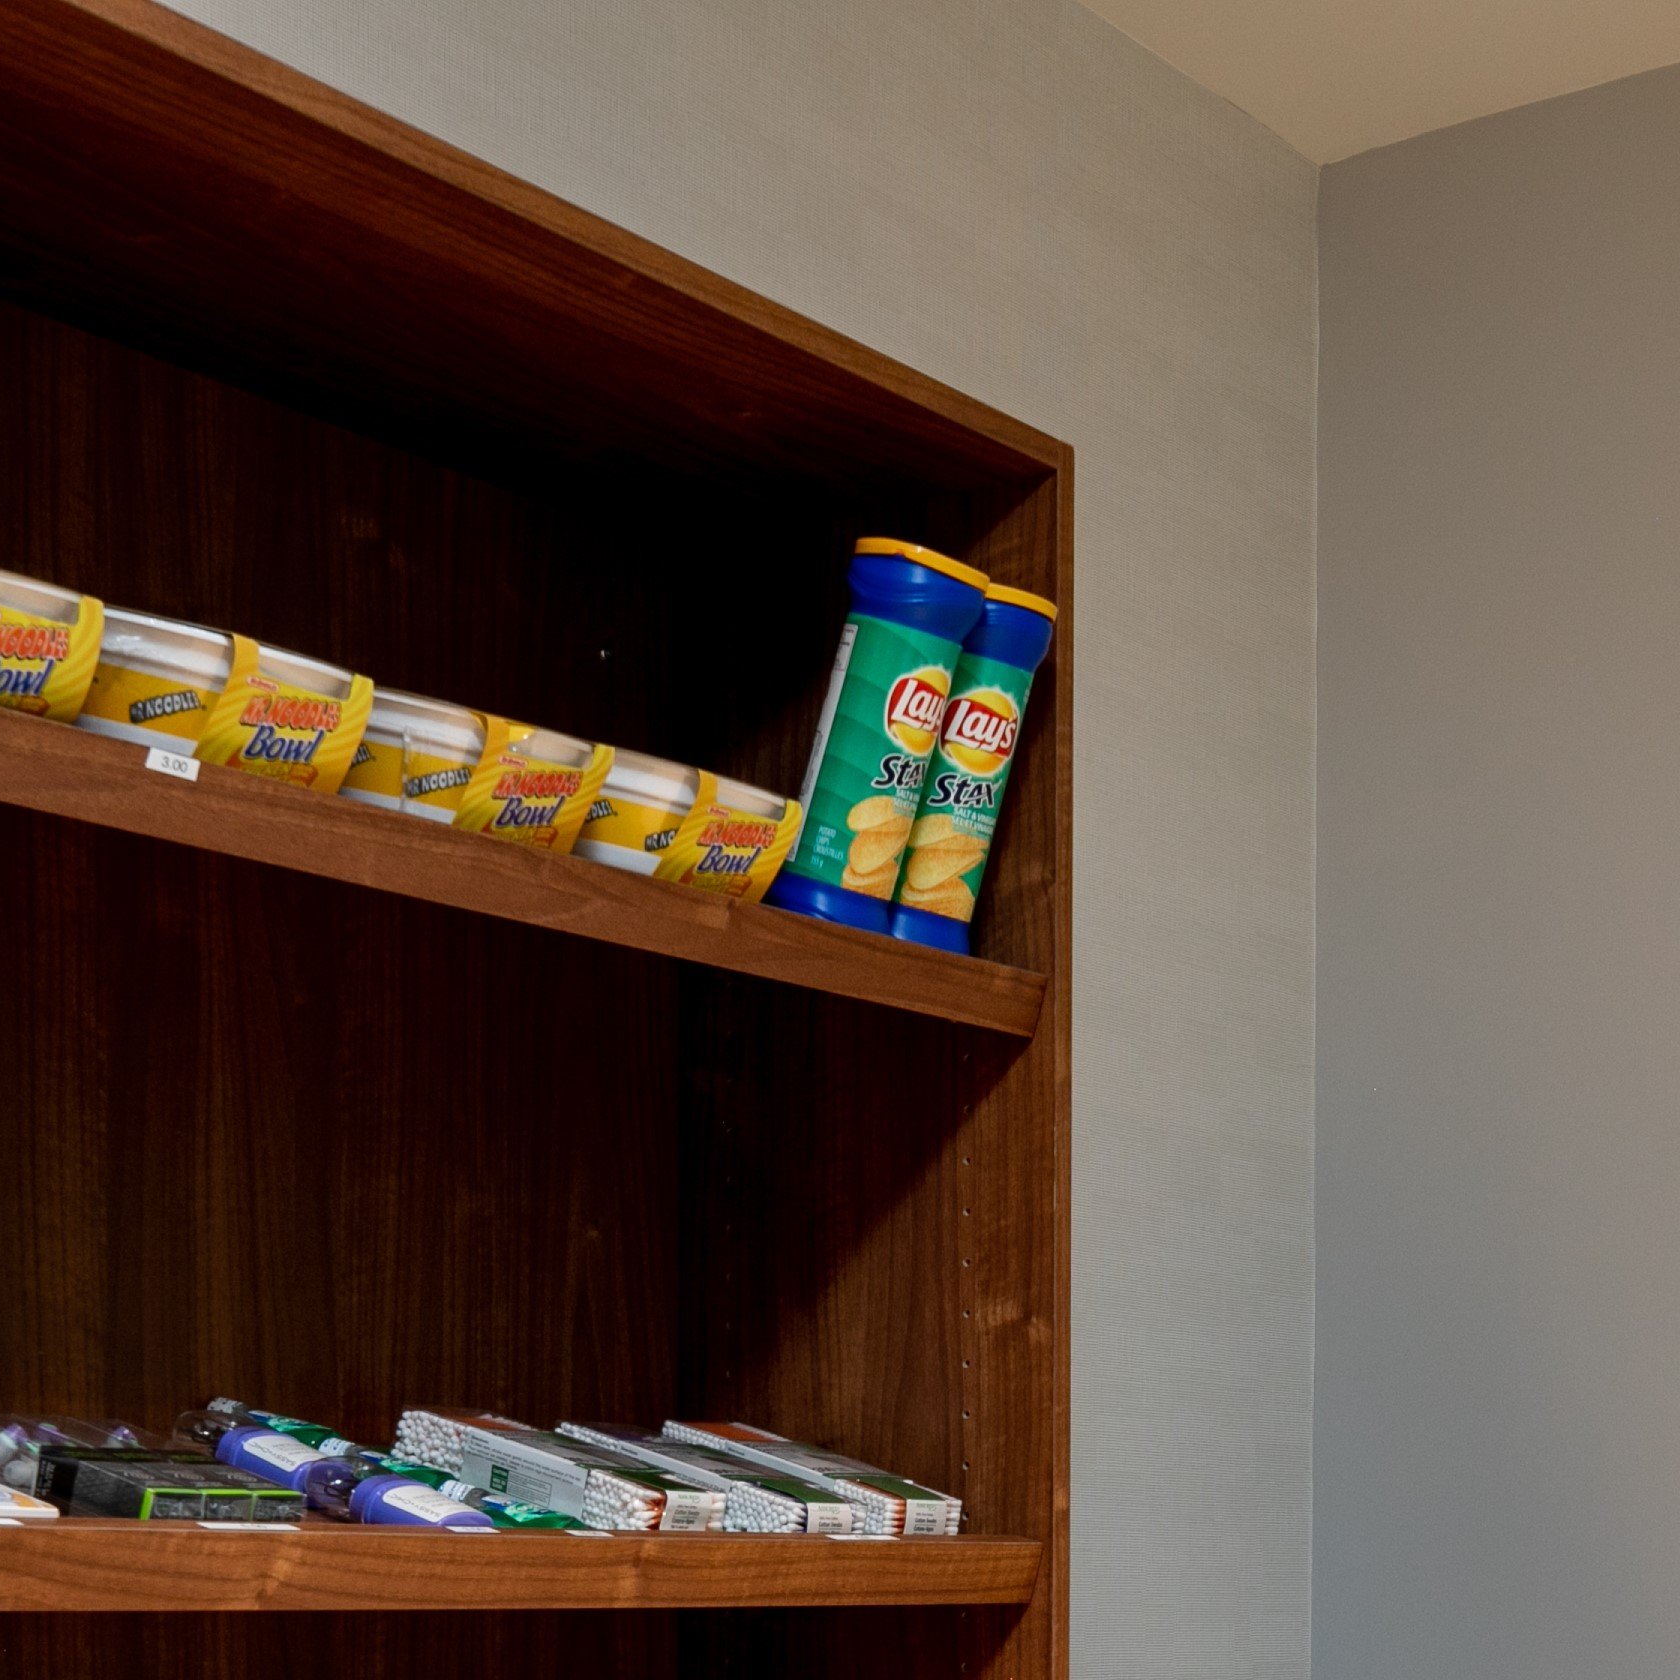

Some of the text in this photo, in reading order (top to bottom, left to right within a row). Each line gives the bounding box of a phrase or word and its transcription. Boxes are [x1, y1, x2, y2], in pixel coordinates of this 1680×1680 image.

[145, 689, 202, 719] NOODLES
[945, 700, 1018, 753] Lay's
[244, 725, 325, 764] Bowl
[160, 756, 188, 774] 3.00
[495, 795, 565, 828] Bowl
[697, 845, 761, 874] Bowl
